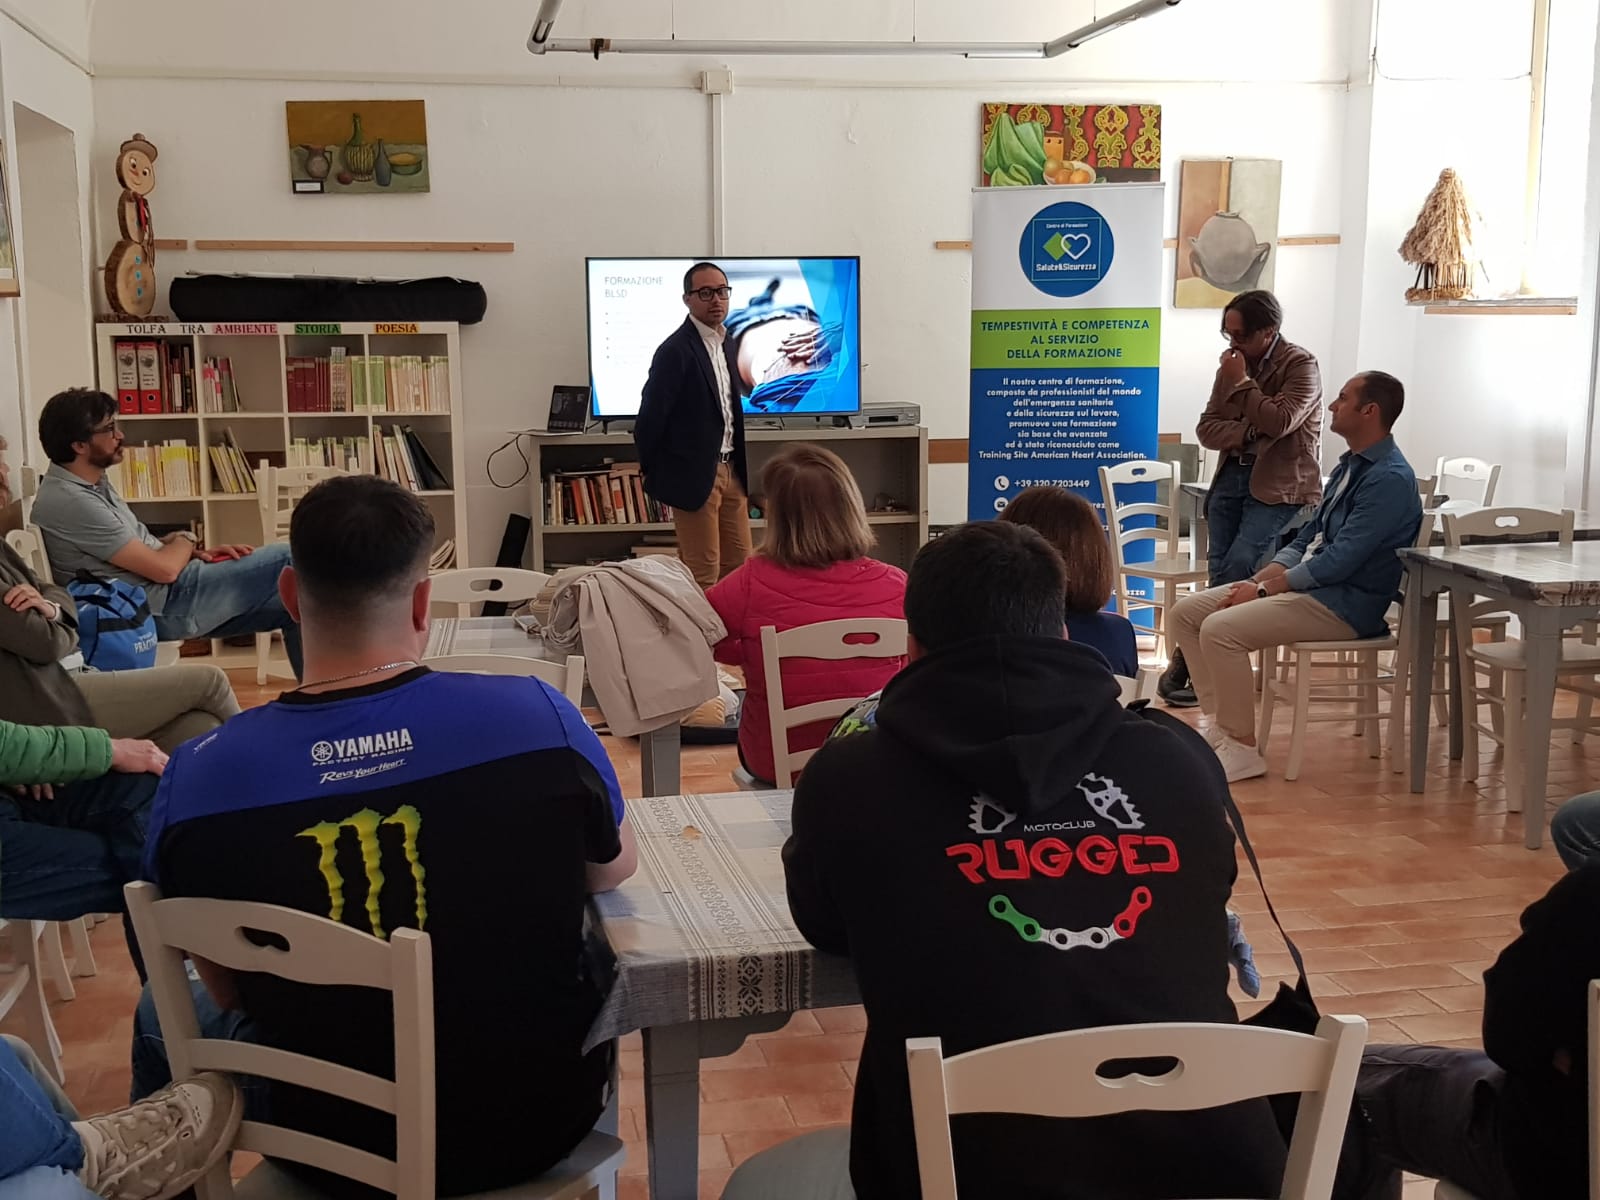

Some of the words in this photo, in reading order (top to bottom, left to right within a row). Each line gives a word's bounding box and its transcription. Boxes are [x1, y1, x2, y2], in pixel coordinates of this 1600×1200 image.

[1036, 263, 1097, 271] Salute&Sicurezza
[604, 276, 663, 285] FORMAZIONE
[605, 289, 627, 298] BLSD
[126, 325, 166, 333] TOLFA
[180, 325, 205, 333] TRA
[215, 324, 277, 333] AMBIENTE
[295, 324, 340, 333] STORIA
[375, 324, 417, 333] POESIA
[981, 319, 1058, 331] TEMPESTIVITÀ
[1062, 321, 1068, 329] E
[1072, 319, 1149, 330] COMPETENZA
[1031, 335, 1044, 344] AL
[1048, 334, 1099, 344] SERVIZIO
[1007, 349, 1040, 359] DELLA
[1044, 348, 1122, 358] FORMAZIONE
[1065, 377, 1073, 385] di
[1075, 377, 1124, 386] formazione,
[987, 389, 1025, 397] composto
[1041, 388, 1094, 397] professionisti
[1097, 387, 1110, 395] del
[1112, 387, 1141, 395] mondo
[1013, 399, 1075, 407] dell'emergenza
[1078, 398, 1113, 406] sanitaria
[1091, 409, 1119, 417] lavoro,
[1009, 421, 1049, 429] promuove
[1070, 419, 1117, 427] formazione
[1017, 440, 1022, 448] è
[1047, 440, 1095, 448] riconosciuto
[979, 451, 1011, 460] Training
[1072, 451, 1094, 459] Heart
[1096, 451, 1147, 459] Association.
[334, 728, 413, 758] YAMAHA
[312, 756, 366, 766] FACTORY
[371, 746, 414, 757] RACING
[320, 770, 354, 784] Revs
[354, 766, 379, 778] Your
[379, 759, 406, 772] Heart
[1023, 821, 1096, 832] MOTOCLUB
[946, 835, 1180, 884] RUGGED
